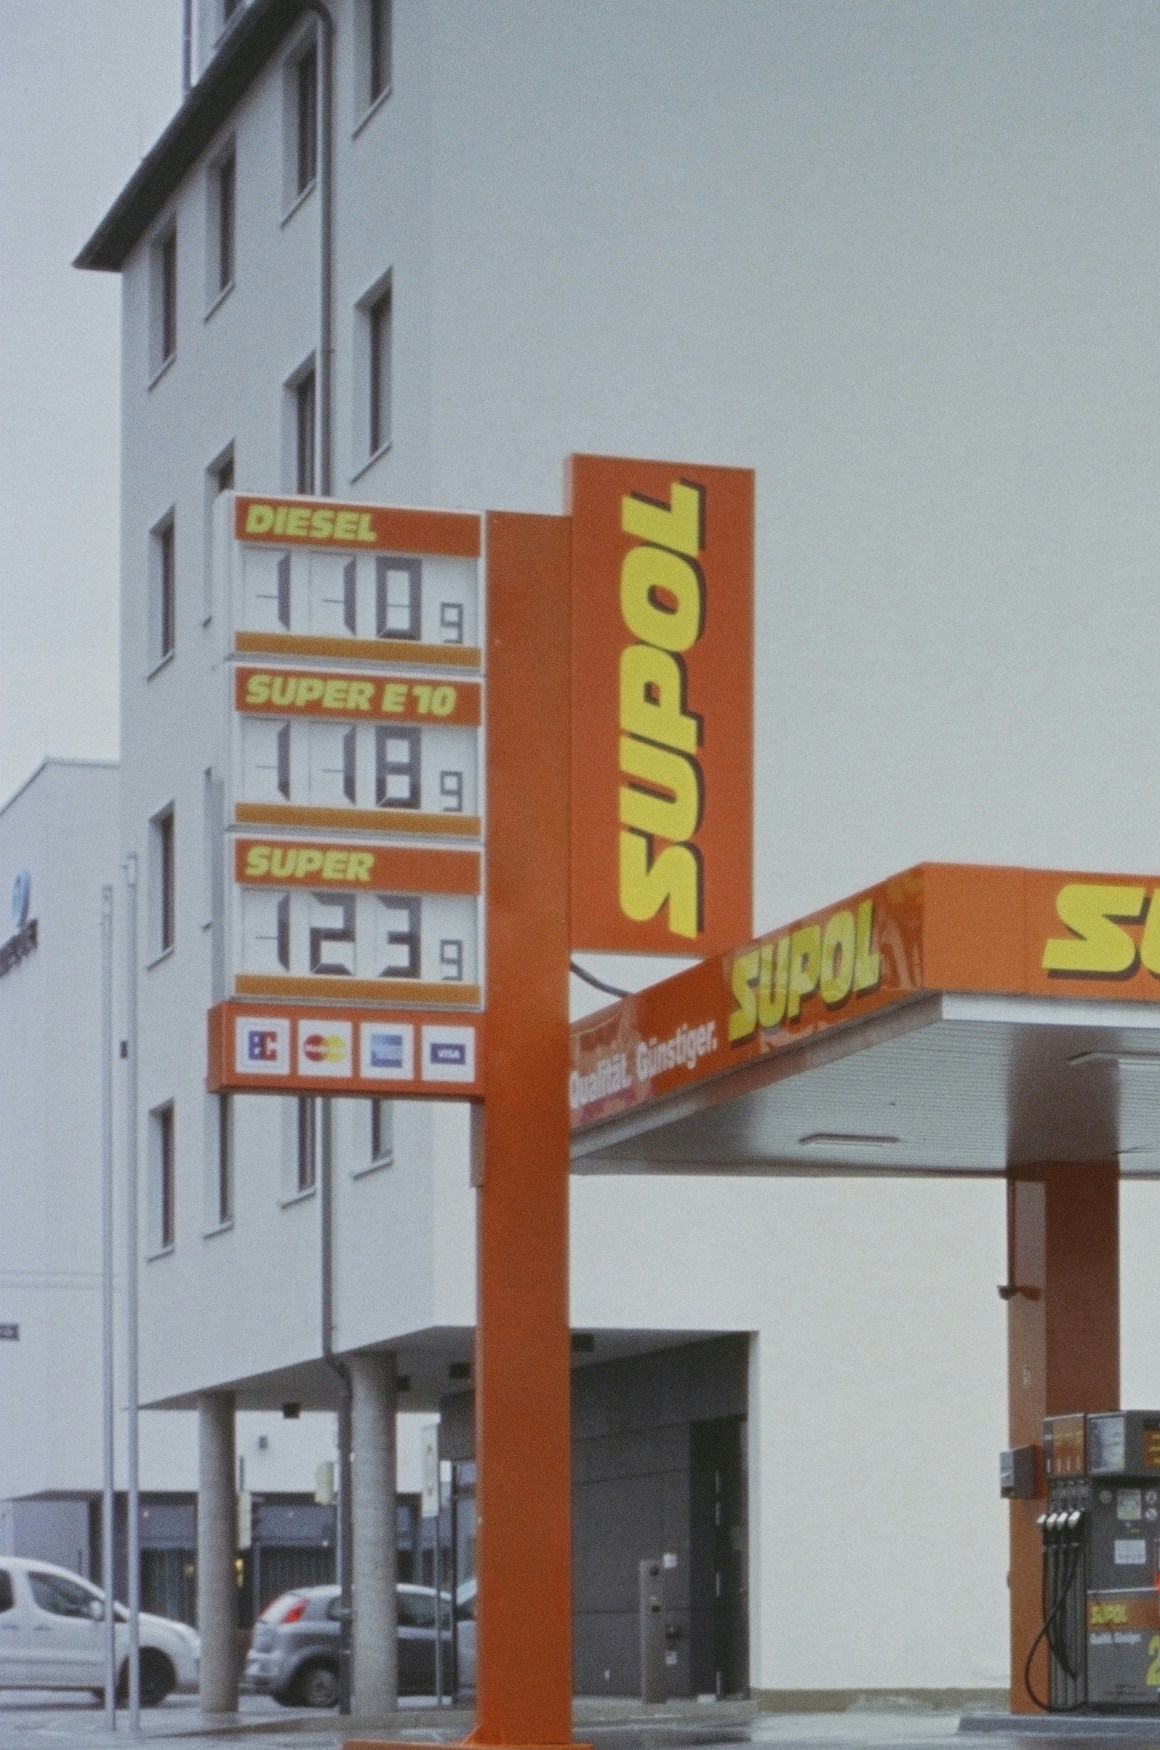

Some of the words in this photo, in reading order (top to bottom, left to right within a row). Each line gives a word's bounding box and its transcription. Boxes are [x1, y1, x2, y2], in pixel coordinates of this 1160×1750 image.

[246, 505, 376, 542] DIESEL
[246, 675, 374, 711] SUPER
[620, 477, 705, 940] SUPOL
[245, 845, 376, 882] SUPER
[727, 899, 881, 1047] SUPOL
[437, 1048, 461, 1060] VISA
